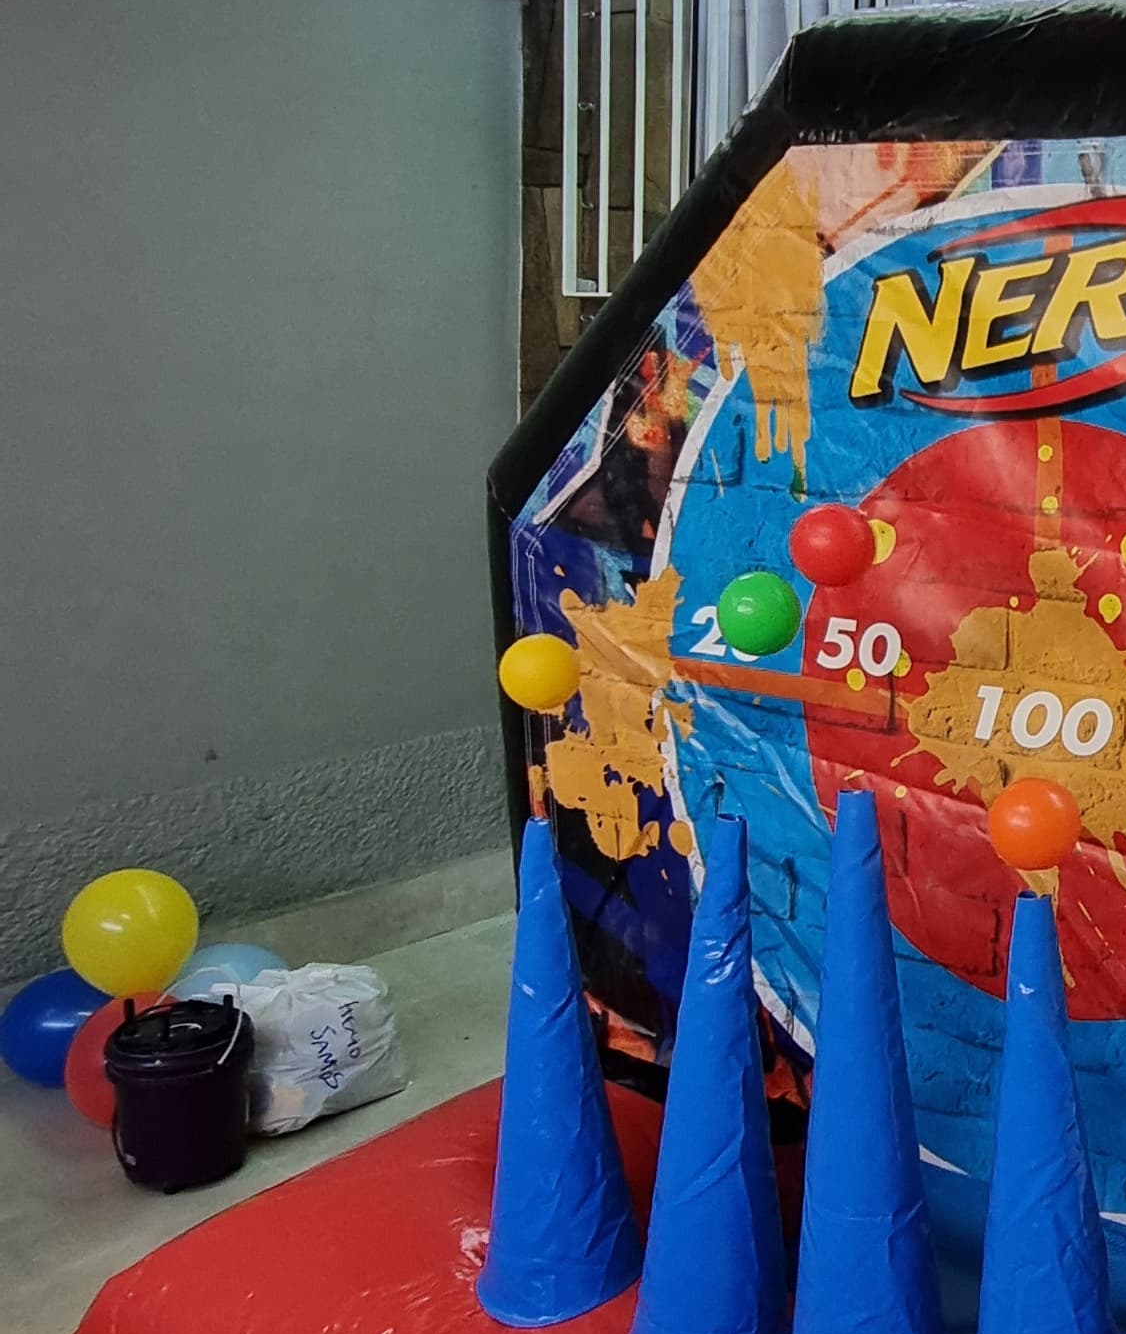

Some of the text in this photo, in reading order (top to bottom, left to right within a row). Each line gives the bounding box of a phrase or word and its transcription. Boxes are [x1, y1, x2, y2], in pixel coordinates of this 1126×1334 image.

[689, 605, 761, 662] 2
[816, 617, 902, 677] 50
[974, 685, 1114, 757] 100
